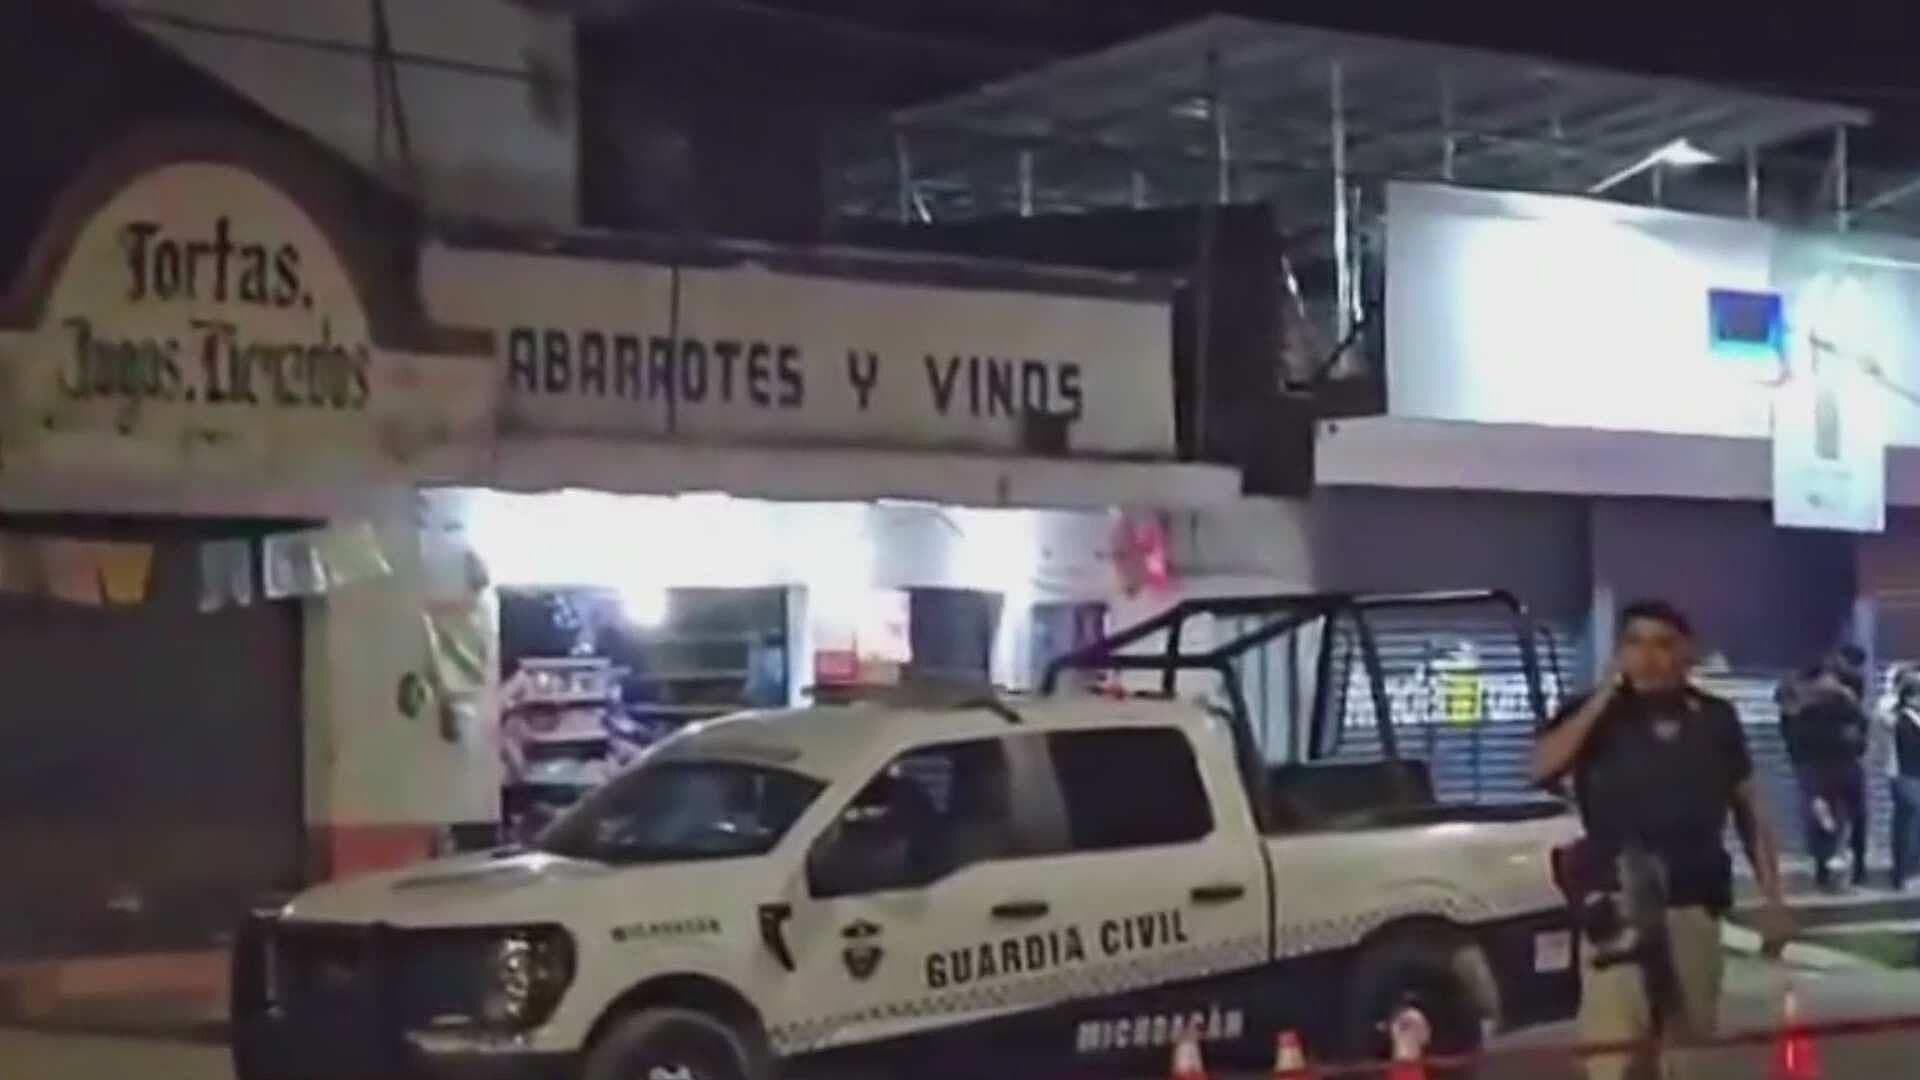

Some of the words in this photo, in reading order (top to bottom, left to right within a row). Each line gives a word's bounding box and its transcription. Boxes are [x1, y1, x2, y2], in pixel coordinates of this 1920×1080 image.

[507, 326, 804, 407] ABARROTES
[847, 350, 879, 411] Y
[925, 353, 1083, 420] VINOS
[926, 925, 1085, 988] GUARDIA
[1100, 909, 1188, 956] CIVIL
